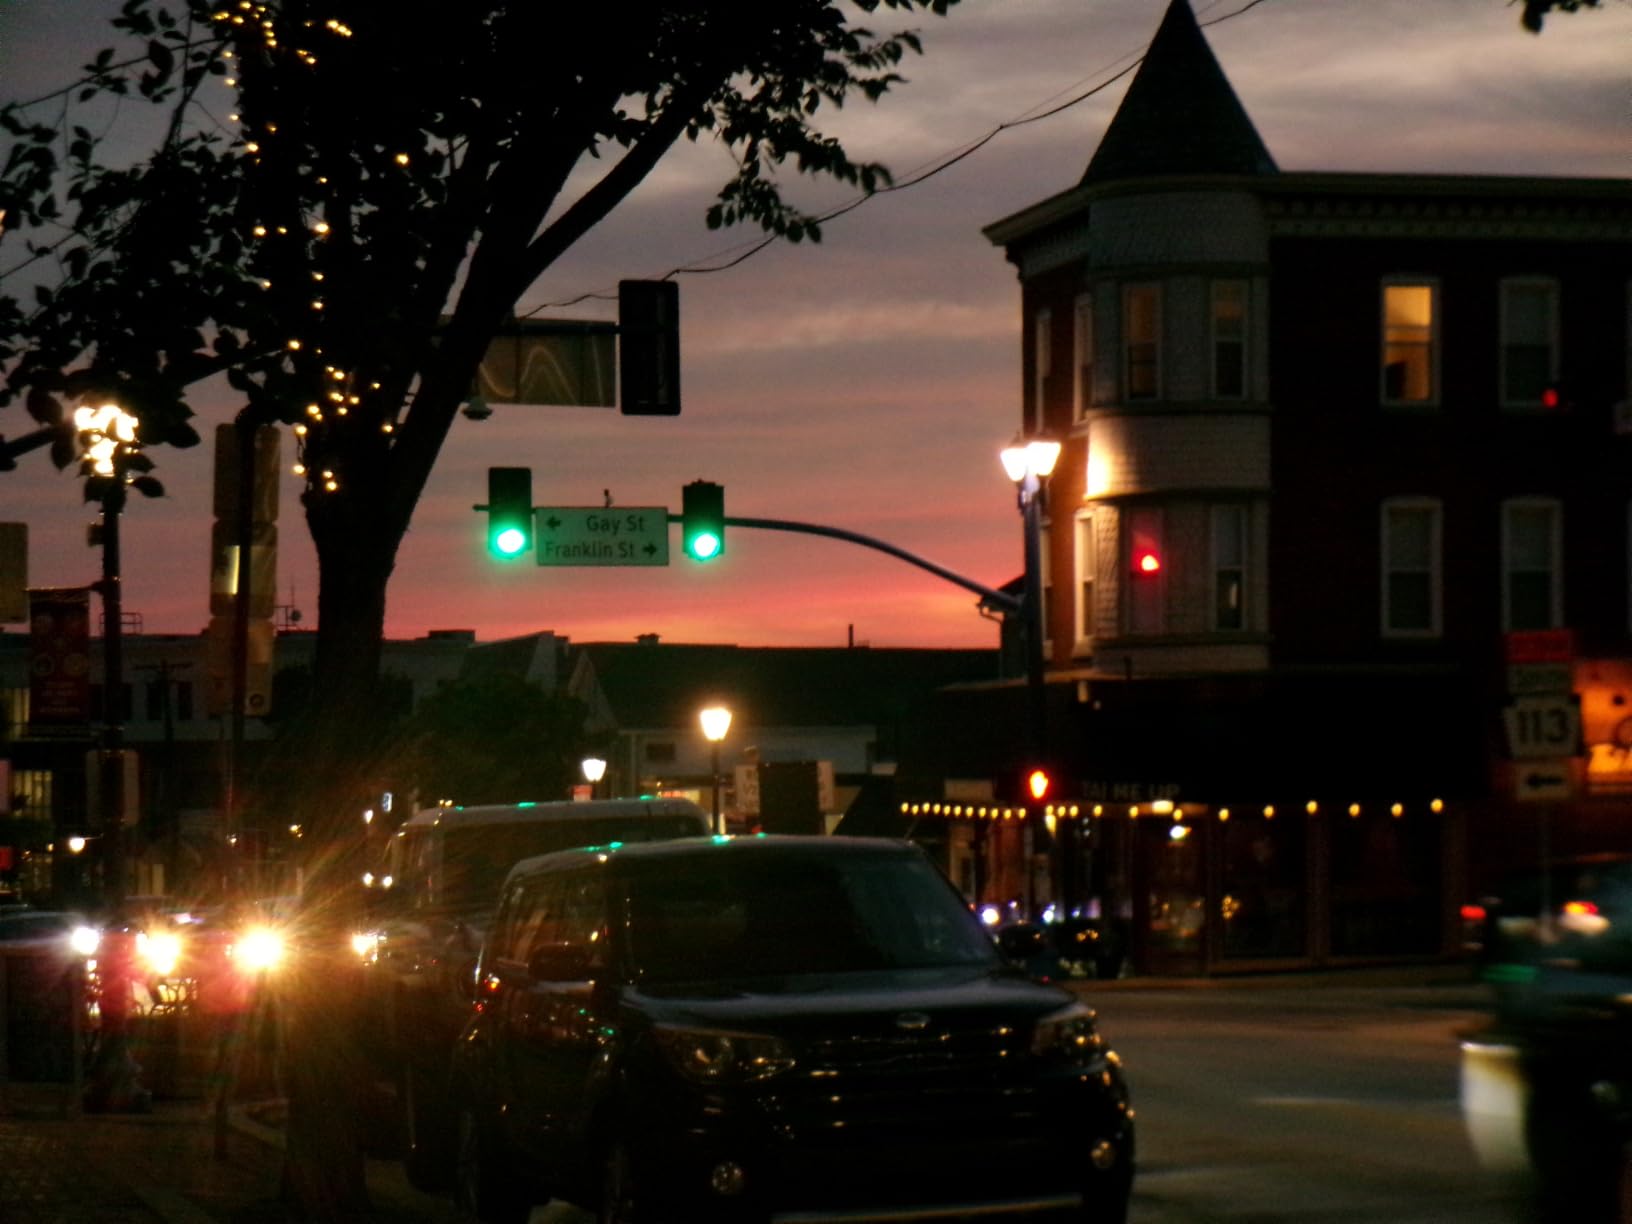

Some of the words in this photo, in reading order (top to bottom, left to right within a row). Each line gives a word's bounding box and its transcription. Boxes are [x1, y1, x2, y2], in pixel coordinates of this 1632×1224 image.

[586, 514, 620, 535] Gay
[626, 514, 645, 532] St
[545, 541, 613, 558] Franklin
[617, 541, 635, 558] St
[1516, 709, 1568, 743] 113
